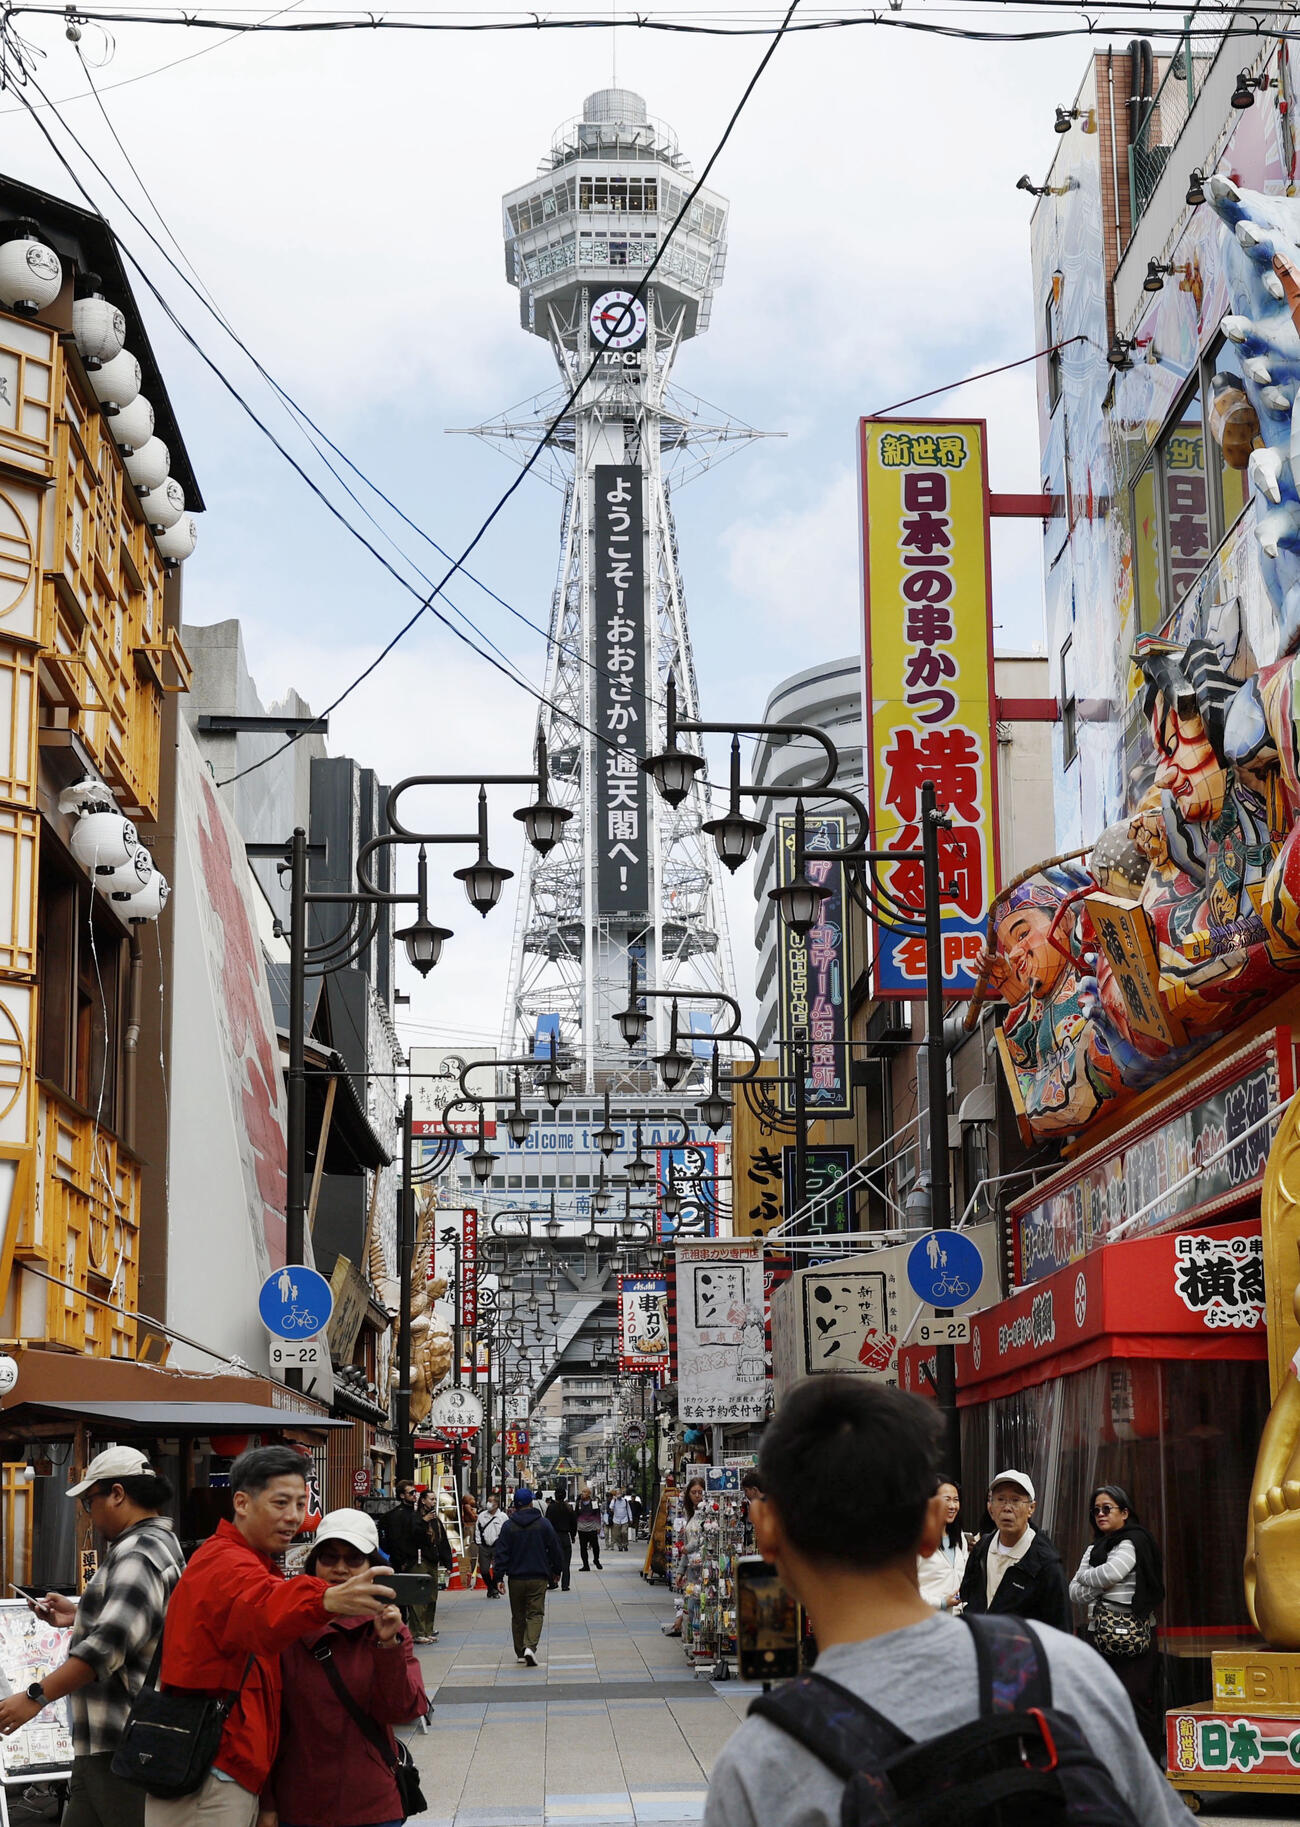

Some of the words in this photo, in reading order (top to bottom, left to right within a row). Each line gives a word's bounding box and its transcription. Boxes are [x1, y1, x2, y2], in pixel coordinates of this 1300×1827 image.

[881, 433, 966, 467] 新世界
[901, 472, 957, 724] 日本一の串かつ
[885, 728, 982, 920] 横綱
[508, 1130, 574, 1149] Welcome
[680, 1248, 760, 1260] 元祖串カツ専門店
[633, 1281, 656, 1291] Asahi
[638, 1293, 661, 1340] 串カツ
[683, 1404, 762, 1418] 宴会予約受付中
[1246, 1665, 1300, 1703] BI
